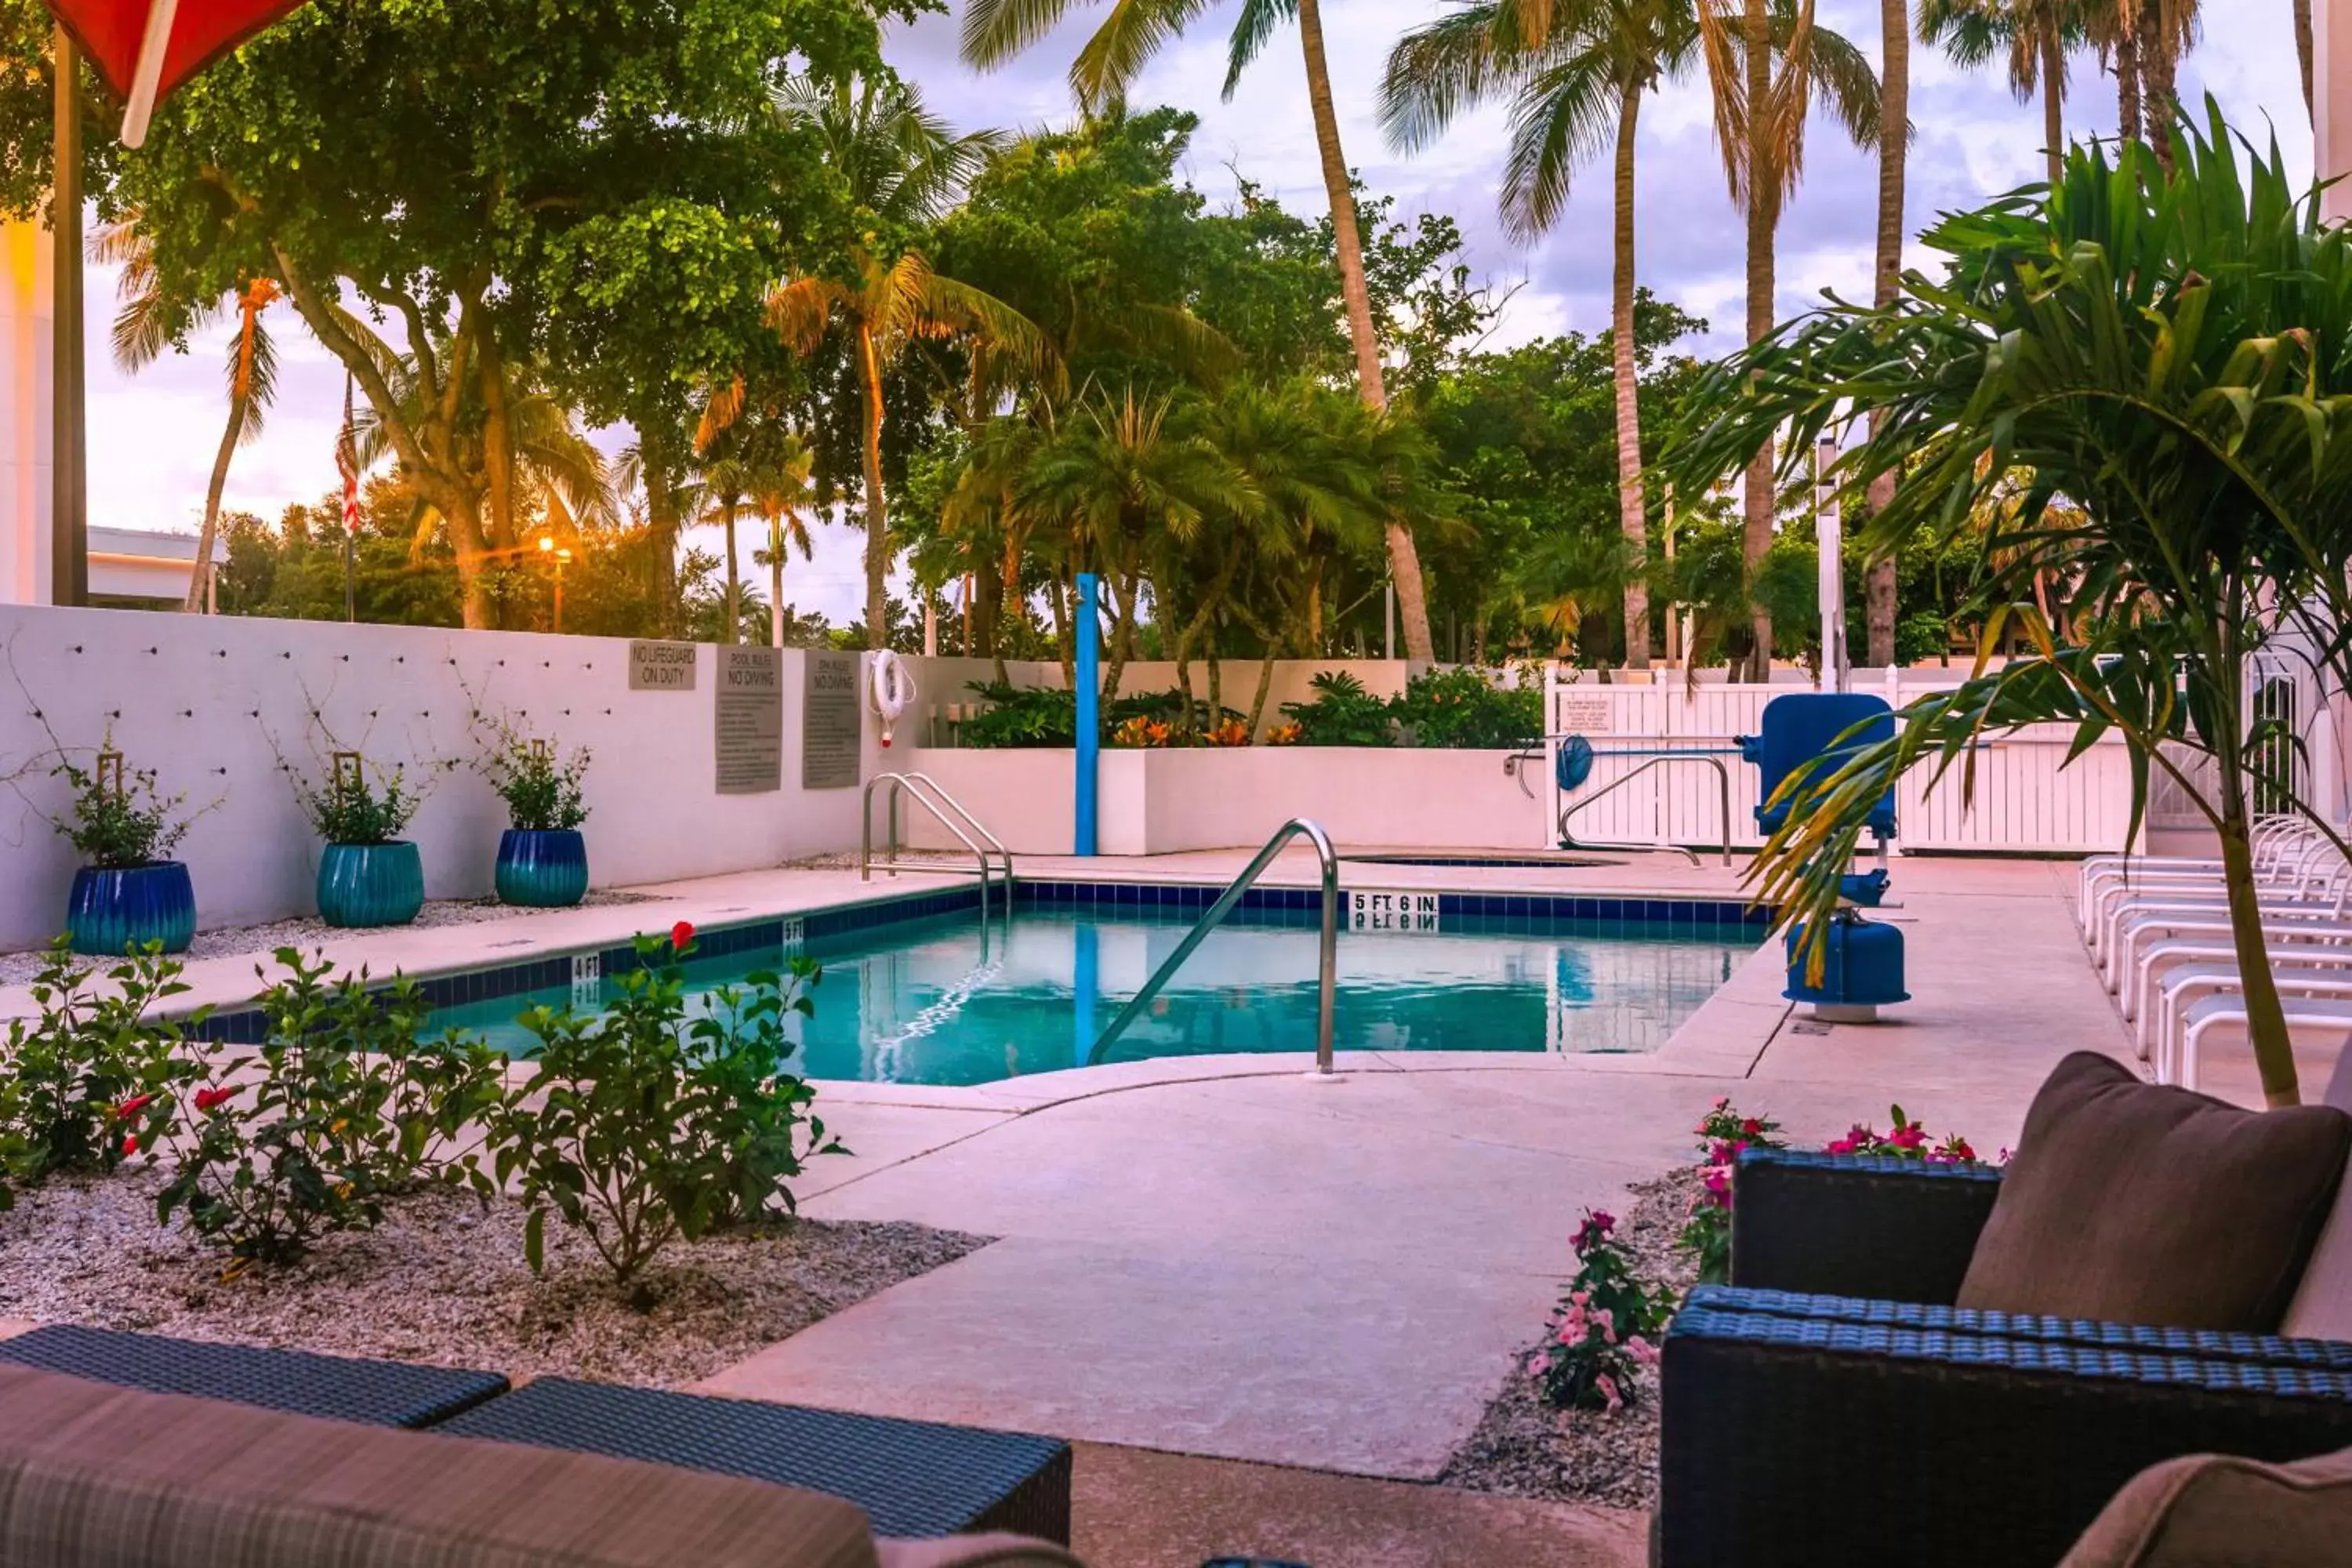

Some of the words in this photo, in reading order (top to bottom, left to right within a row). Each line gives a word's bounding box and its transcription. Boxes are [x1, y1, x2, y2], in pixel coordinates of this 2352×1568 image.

[633, 645, 647, 662] NO
[648, 646, 695, 664] LIFEGUARD
[731, 653, 750, 666] POOL
[642, 666, 658, 684] ON
[660, 667, 684, 684] DUTY
[728, 670, 742, 685] NO
[745, 670, 775, 687] DIVING
[815, 674, 826, 690] NO
[828, 675, 854, 690] DIVING
[1355, 895, 1365, 910] 5
[1399, 895, 1410, 911] 6
[1417, 896, 1437, 912] IN.
[575, 958, 583, 980] 4
[586, 956, 598, 978] FT
